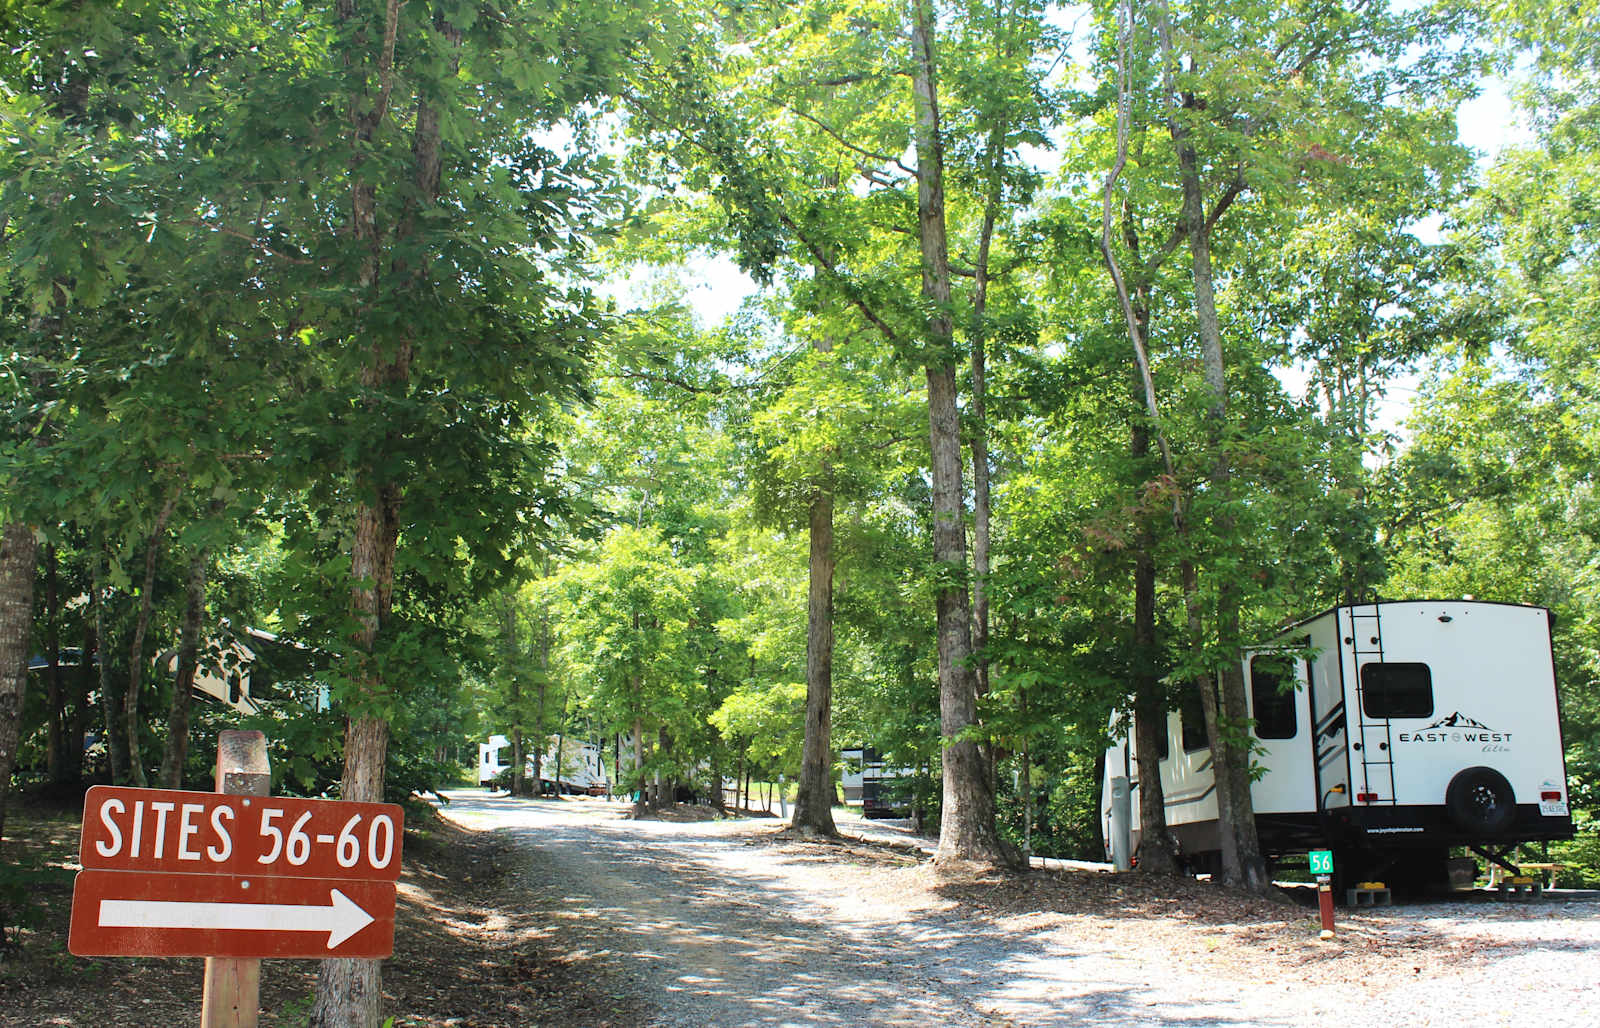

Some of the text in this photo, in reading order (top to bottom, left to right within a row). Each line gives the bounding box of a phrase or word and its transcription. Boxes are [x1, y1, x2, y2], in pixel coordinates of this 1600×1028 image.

[1399, 733, 1447, 742] EAST
[1464, 733, 1512, 742] WEST
[95, 798, 395, 870] SITES 56-60
[1312, 855, 1330, 871] 56
